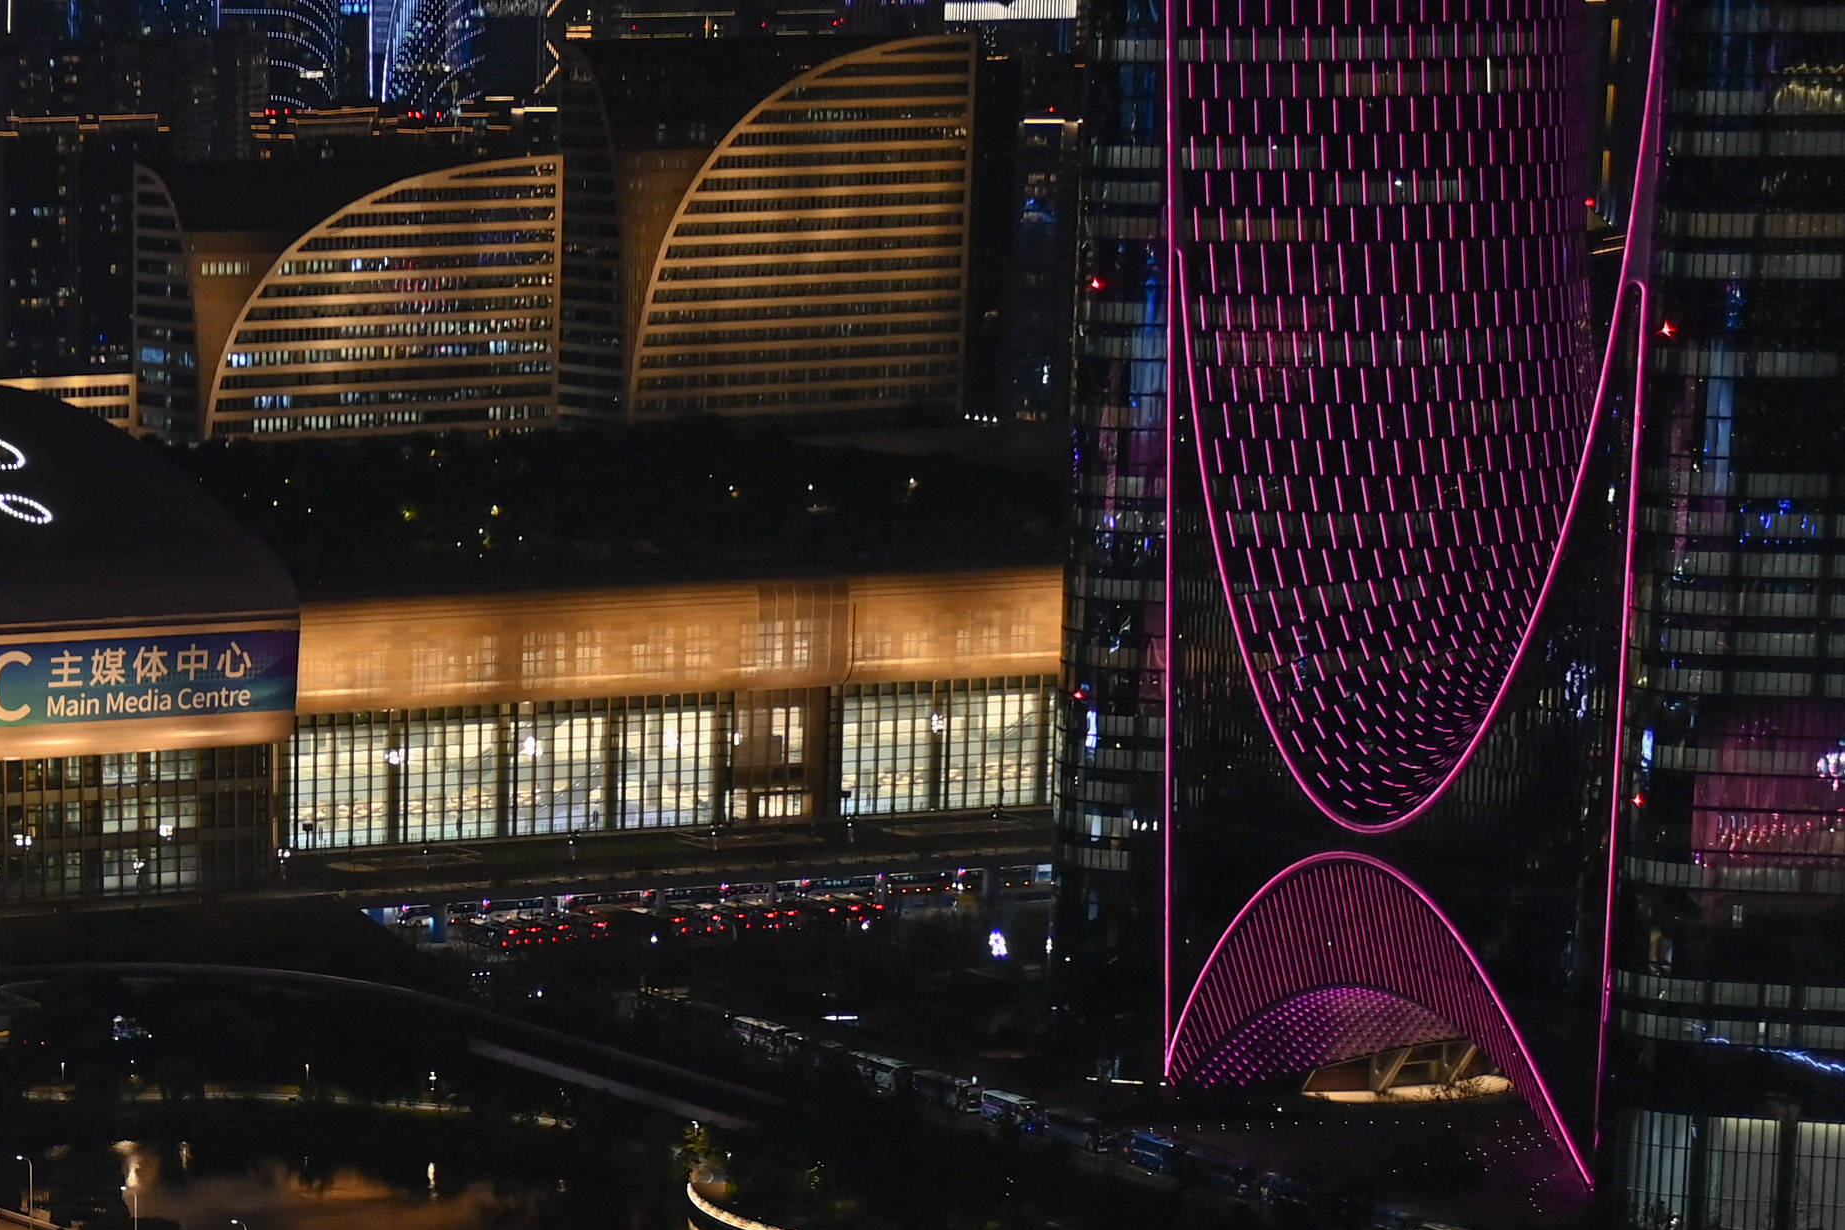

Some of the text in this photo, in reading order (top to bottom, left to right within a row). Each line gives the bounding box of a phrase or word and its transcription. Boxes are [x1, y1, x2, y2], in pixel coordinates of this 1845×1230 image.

[47, 640, 252, 689] 主媒体中心
[47, 685, 251, 718] Main Media Centre
